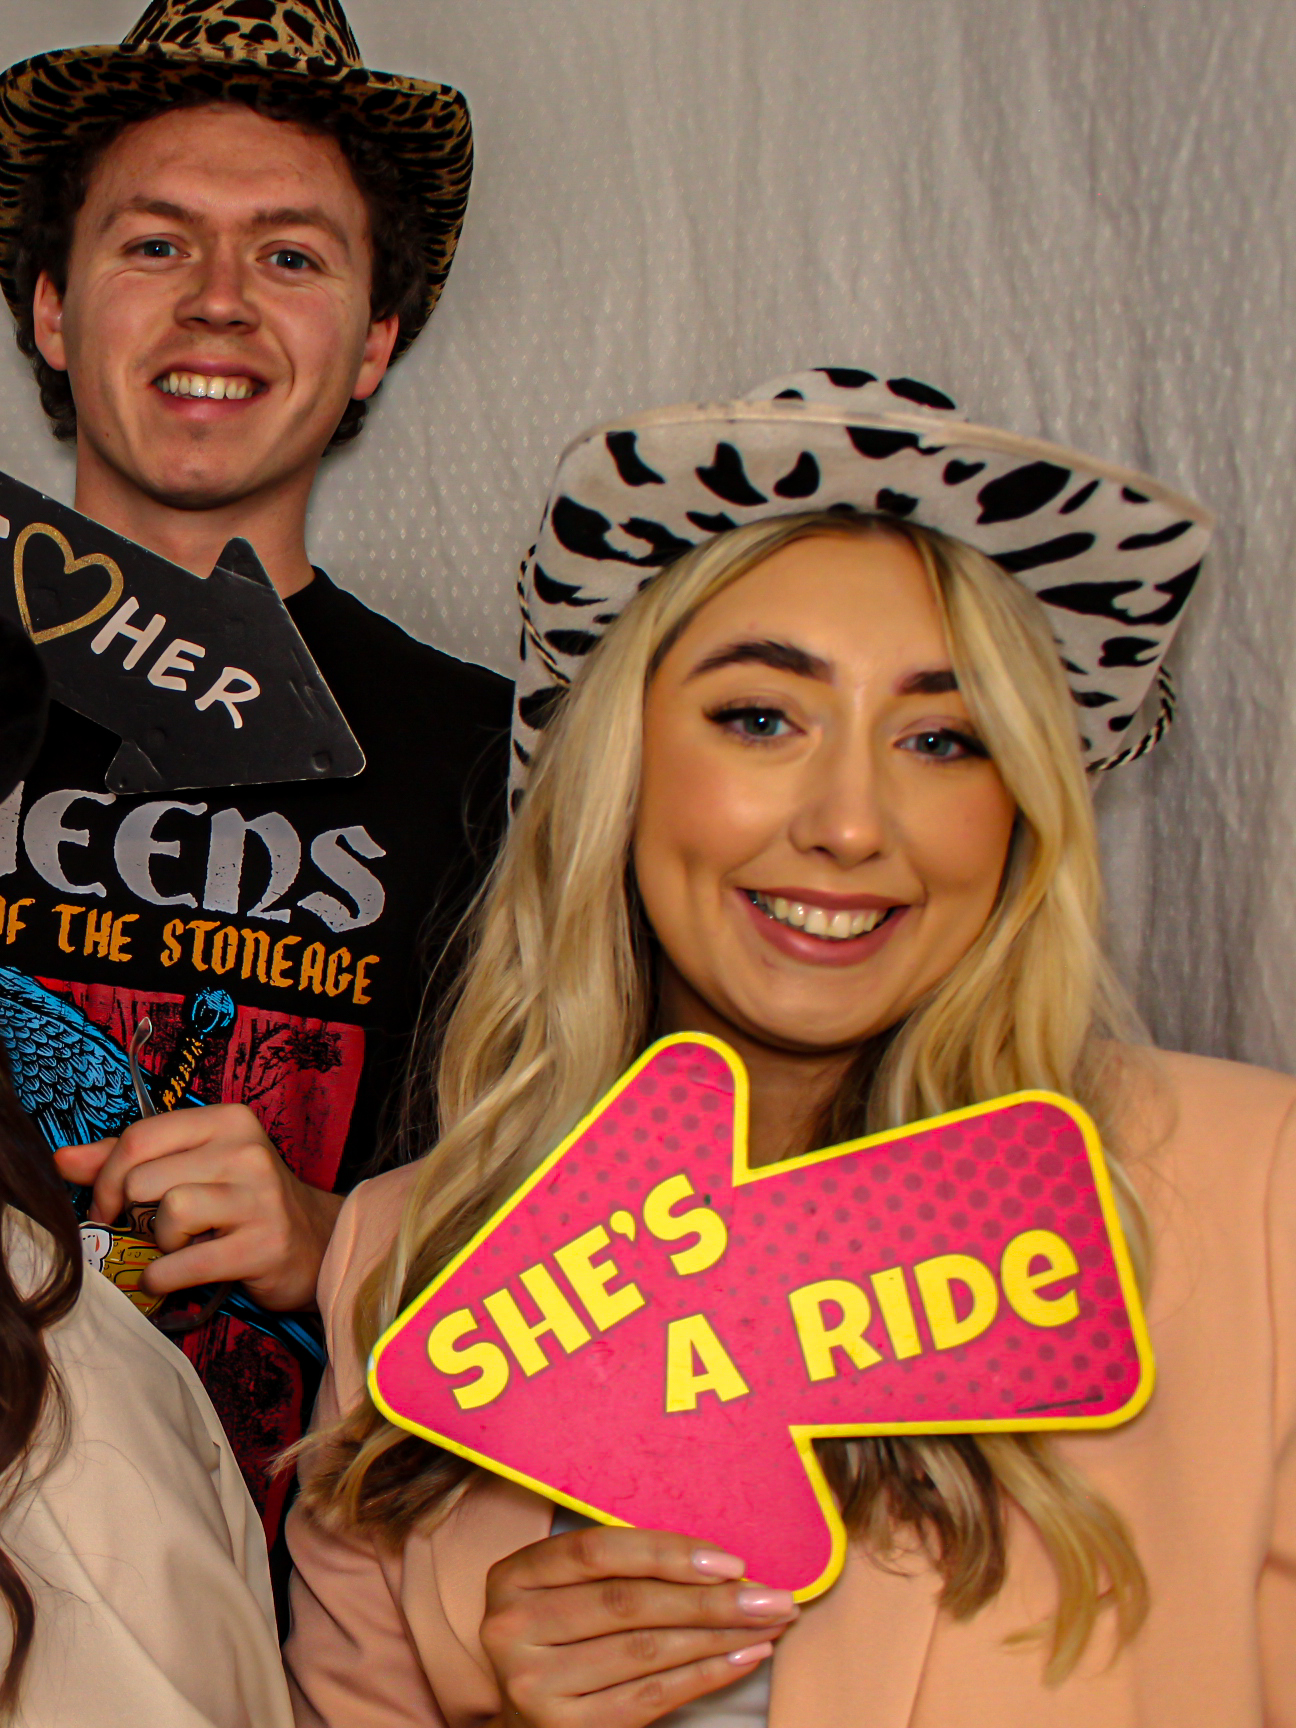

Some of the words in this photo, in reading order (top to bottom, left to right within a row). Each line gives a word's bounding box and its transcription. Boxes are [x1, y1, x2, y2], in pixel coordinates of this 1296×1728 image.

[87, 596, 261, 729] HER
[52, 903, 140, 962] THE
[426, 1173, 728, 1410] SHE'S
[664, 1313, 750, 1413] A
